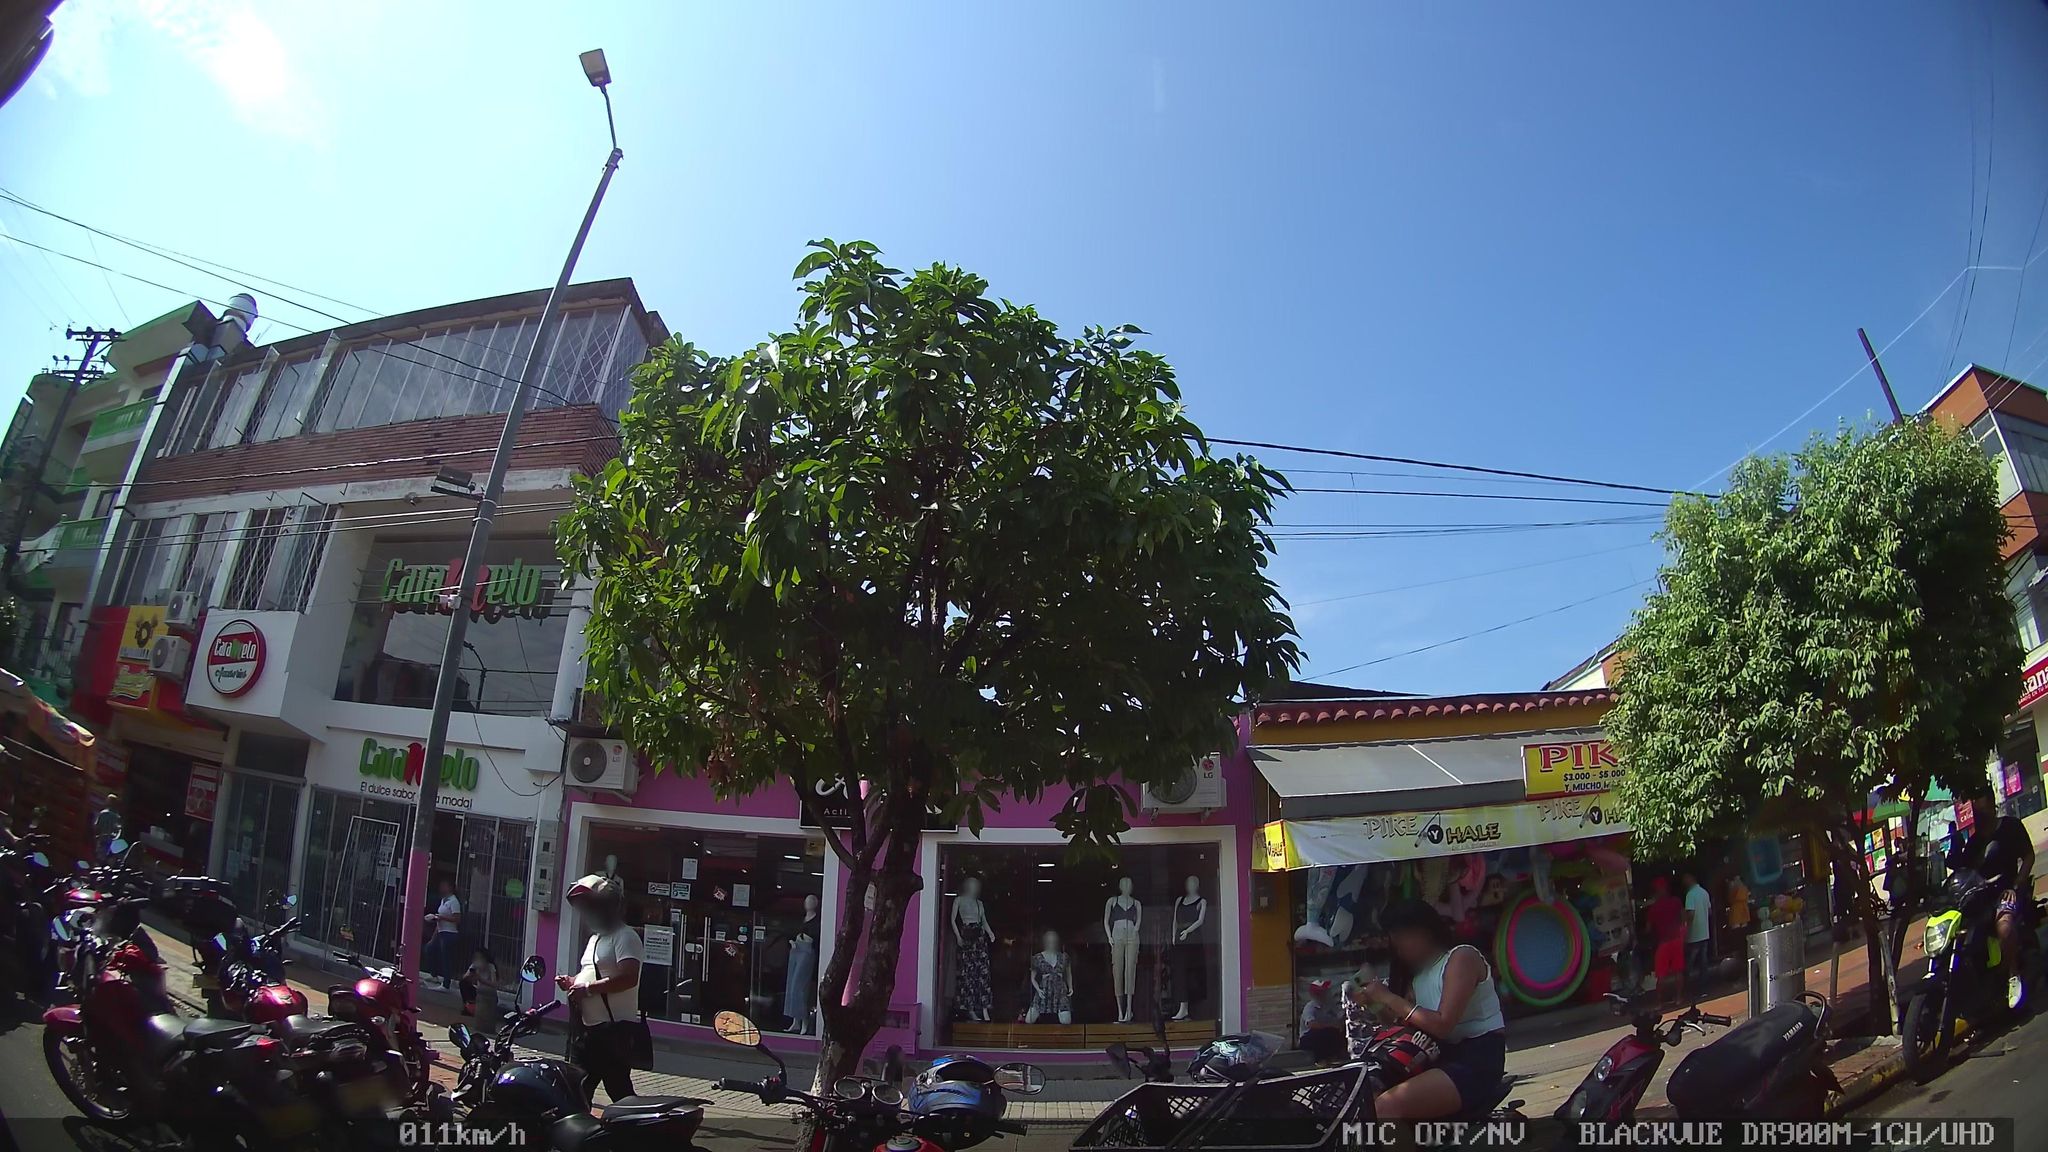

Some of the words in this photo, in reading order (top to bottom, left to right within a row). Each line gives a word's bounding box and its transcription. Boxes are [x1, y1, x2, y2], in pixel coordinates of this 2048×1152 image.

[1539, 743, 1619, 772] PIK
[1563, 772, 1590, 782] $3.000
[1564, 783, 1570, 792] Y
[1572, 781, 1602, 792] MUCHO
[360, 781, 368, 792] El
[368, 783, 391, 796] dulce
[392, 787, 417, 800] sabor
[1537, 799, 1582, 822] PIKE
[1363, 816, 1419, 840] PIKE
[1446, 823, 1502, 845] HALE
[1783, 1021, 1804, 1041] YAMAHA
